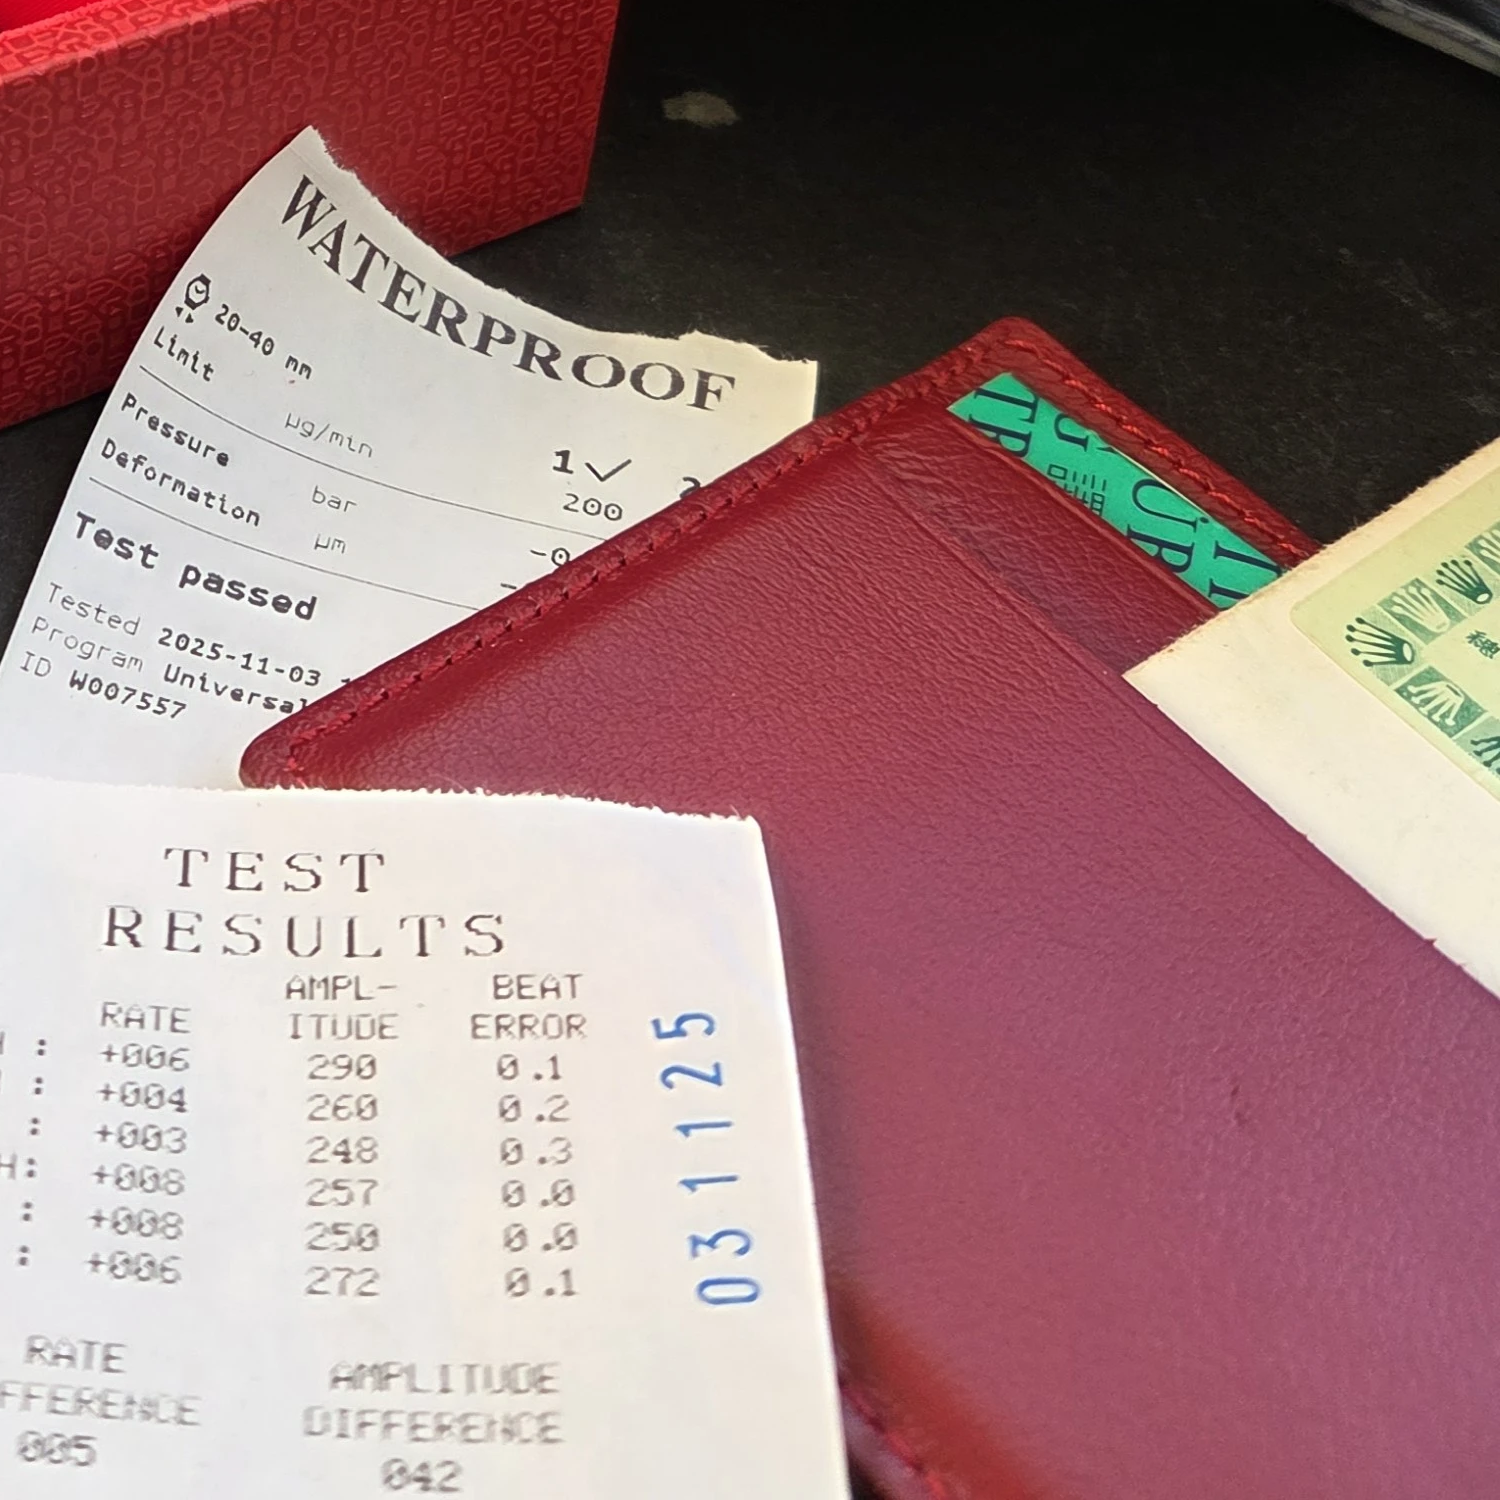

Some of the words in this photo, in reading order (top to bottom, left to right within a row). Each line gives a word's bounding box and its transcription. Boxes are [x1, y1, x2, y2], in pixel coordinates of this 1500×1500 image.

[281, 174, 736, 411] WATERPROOF
[215, 303, 275, 356] 20-40
[285, 355, 313, 380] mm
[153, 326, 214, 382] Limit
[563, 492, 623, 521] 200
[120, 392, 230, 467] Pressure
[311, 484, 358, 513] bar
[552, 449, 574, 475] 1
[100, 437, 261, 527] Deformation
[74, 511, 160, 570] Test
[179, 563, 319, 621] passed
[31, 616, 145, 673] Program
[47, 582, 142, 636] Tested
[158, 627, 322, 687] 2025-11-03
[19, 651, 52, 678] ID
[69, 669, 188, 720] W007557
[163, 847, 386, 894] TEST
[100, 904, 505, 959] RESULTS
[285, 974, 398, 1001] AMPL-
[493, 973, 584, 1000] BEAT
[100, 1001, 192, 1034] RATE
[288, 1013, 400, 1040] ITUDE
[470, 1013, 588, 1040] ERROR
[100, 1042, 190, 1072] +006
[307, 1053, 377, 1080] 290
[97, 1080, 188, 1113] +004
[307, 1094, 378, 1121] 260
[95, 1121, 187, 1154] +003
[306, 1135, 378, 1164] 248
[92, 1162, 186, 1196] +008
[305, 1178, 378, 1207] 257
[89, 1206, 183, 1240] +008
[305, 1221, 379, 1251] 250
[85, 1251, 182, 1285] +006
[305, 1266, 380, 1296] 272
[23, 1334, 127, 1374] RATE
[329, 1361, 561, 1396] AMPLITUDE
[302, 1405, 565, 1444] DIFFERENCE
[17, 1430, 98, 1468] 005
[381, 1458, 464, 1494] 042
